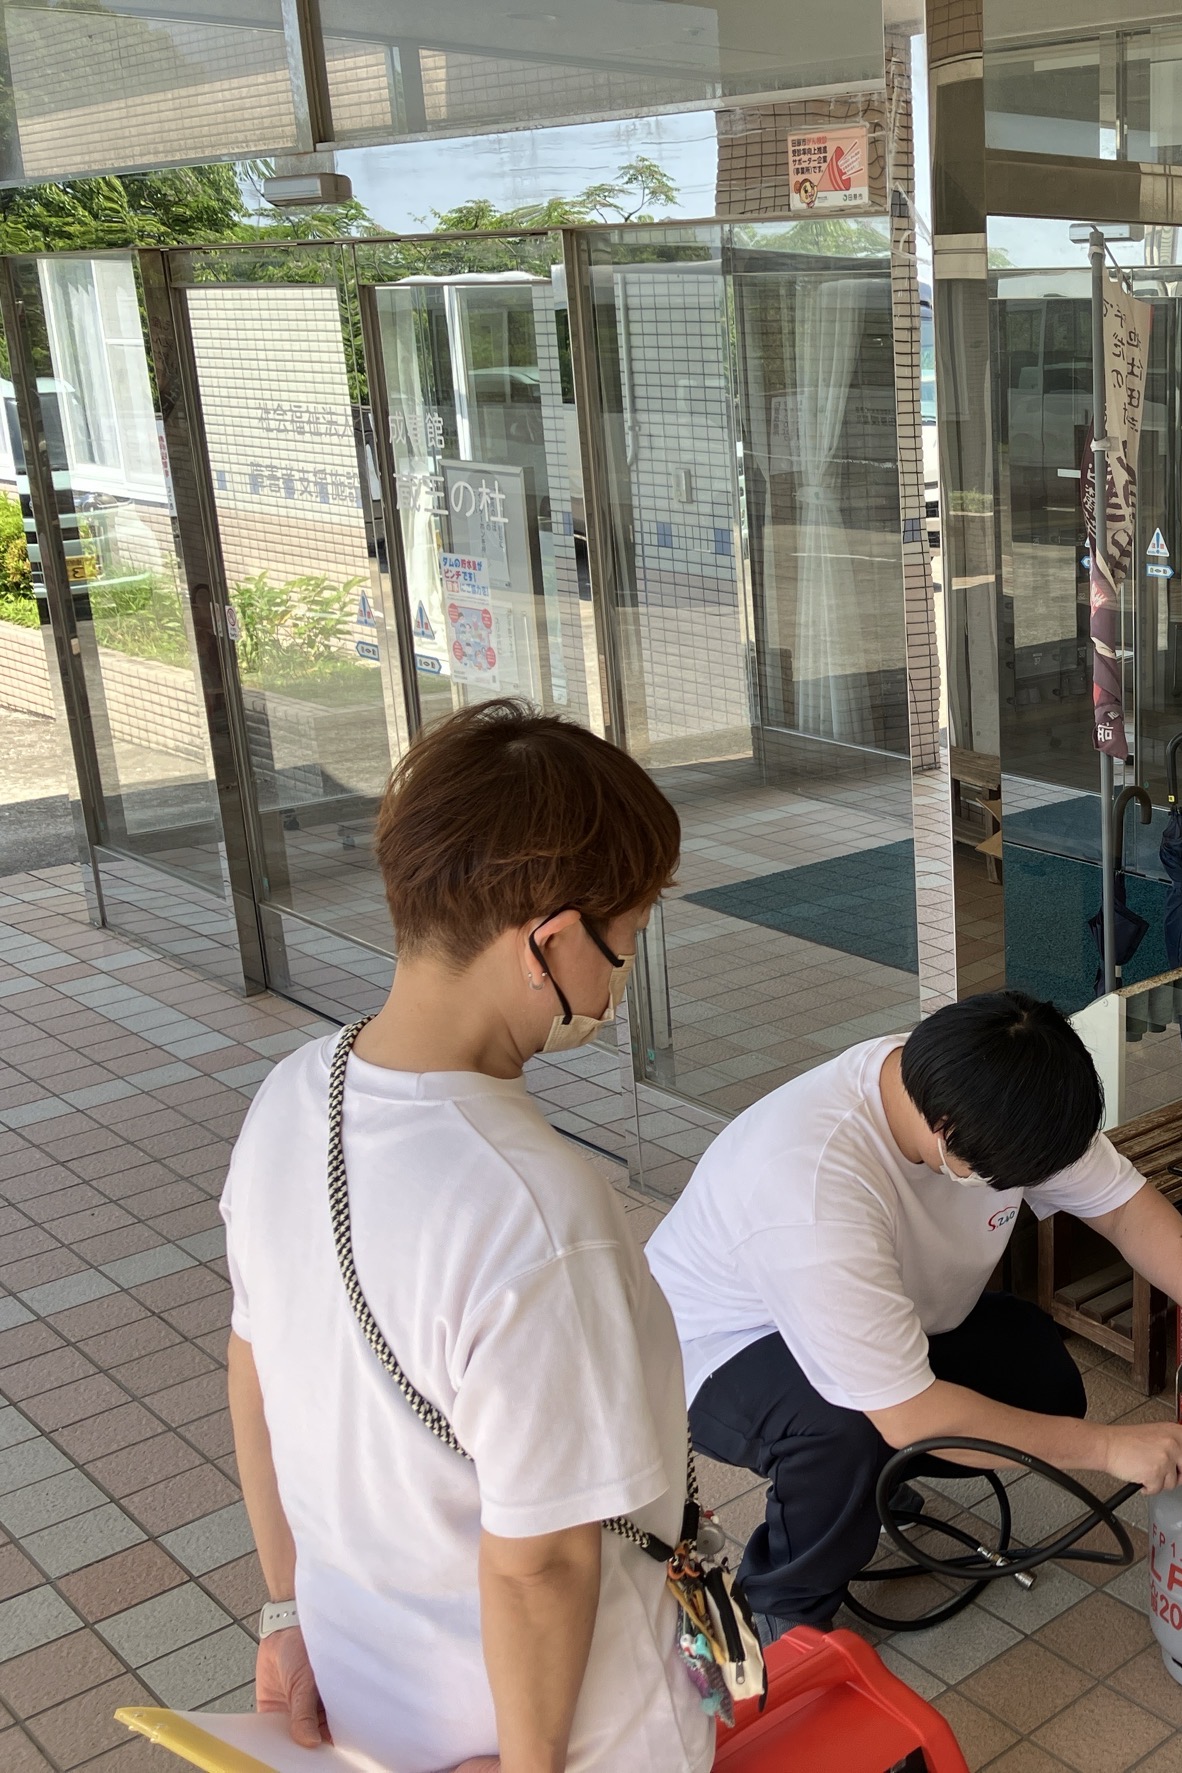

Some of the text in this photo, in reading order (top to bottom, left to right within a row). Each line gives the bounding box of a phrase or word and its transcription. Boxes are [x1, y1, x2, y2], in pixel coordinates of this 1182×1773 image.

[792, 155, 828, 167] サポーター企業
[392, 473, 509, 524] 蔵王の杜
